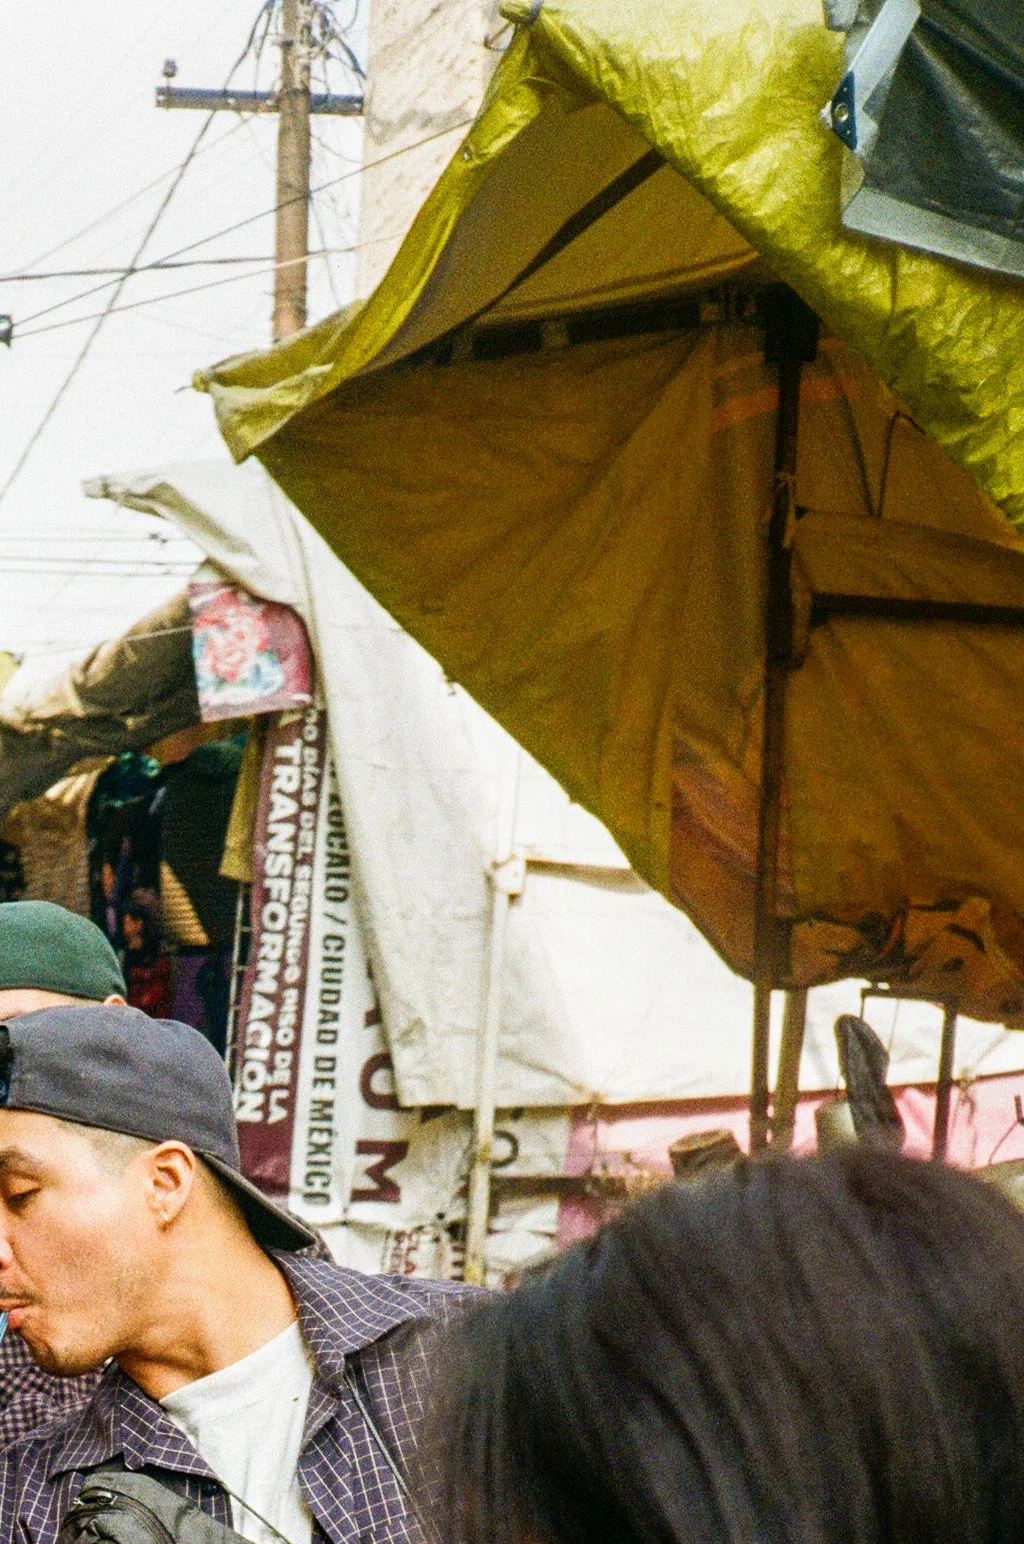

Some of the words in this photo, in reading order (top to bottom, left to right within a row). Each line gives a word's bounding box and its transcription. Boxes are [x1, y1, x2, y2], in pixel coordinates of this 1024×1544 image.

[300, 746, 322, 806] DÍAS
[296, 811, 316, 861] DEL
[234, 738, 302, 1123] TRANSFORMACIÓN
[283, 865, 313, 984] SEGUNDO
[276, 988, 301, 1047] PISO
[316, 933, 346, 1046] CIUDAD
[272, 1050, 293, 1084] DE
[313, 1057, 336, 1089] DE
[350, 962, 410, 1204] UM
[266, 1089, 290, 1124] LA
[302, 1099, 338, 1208] MÉXICO
